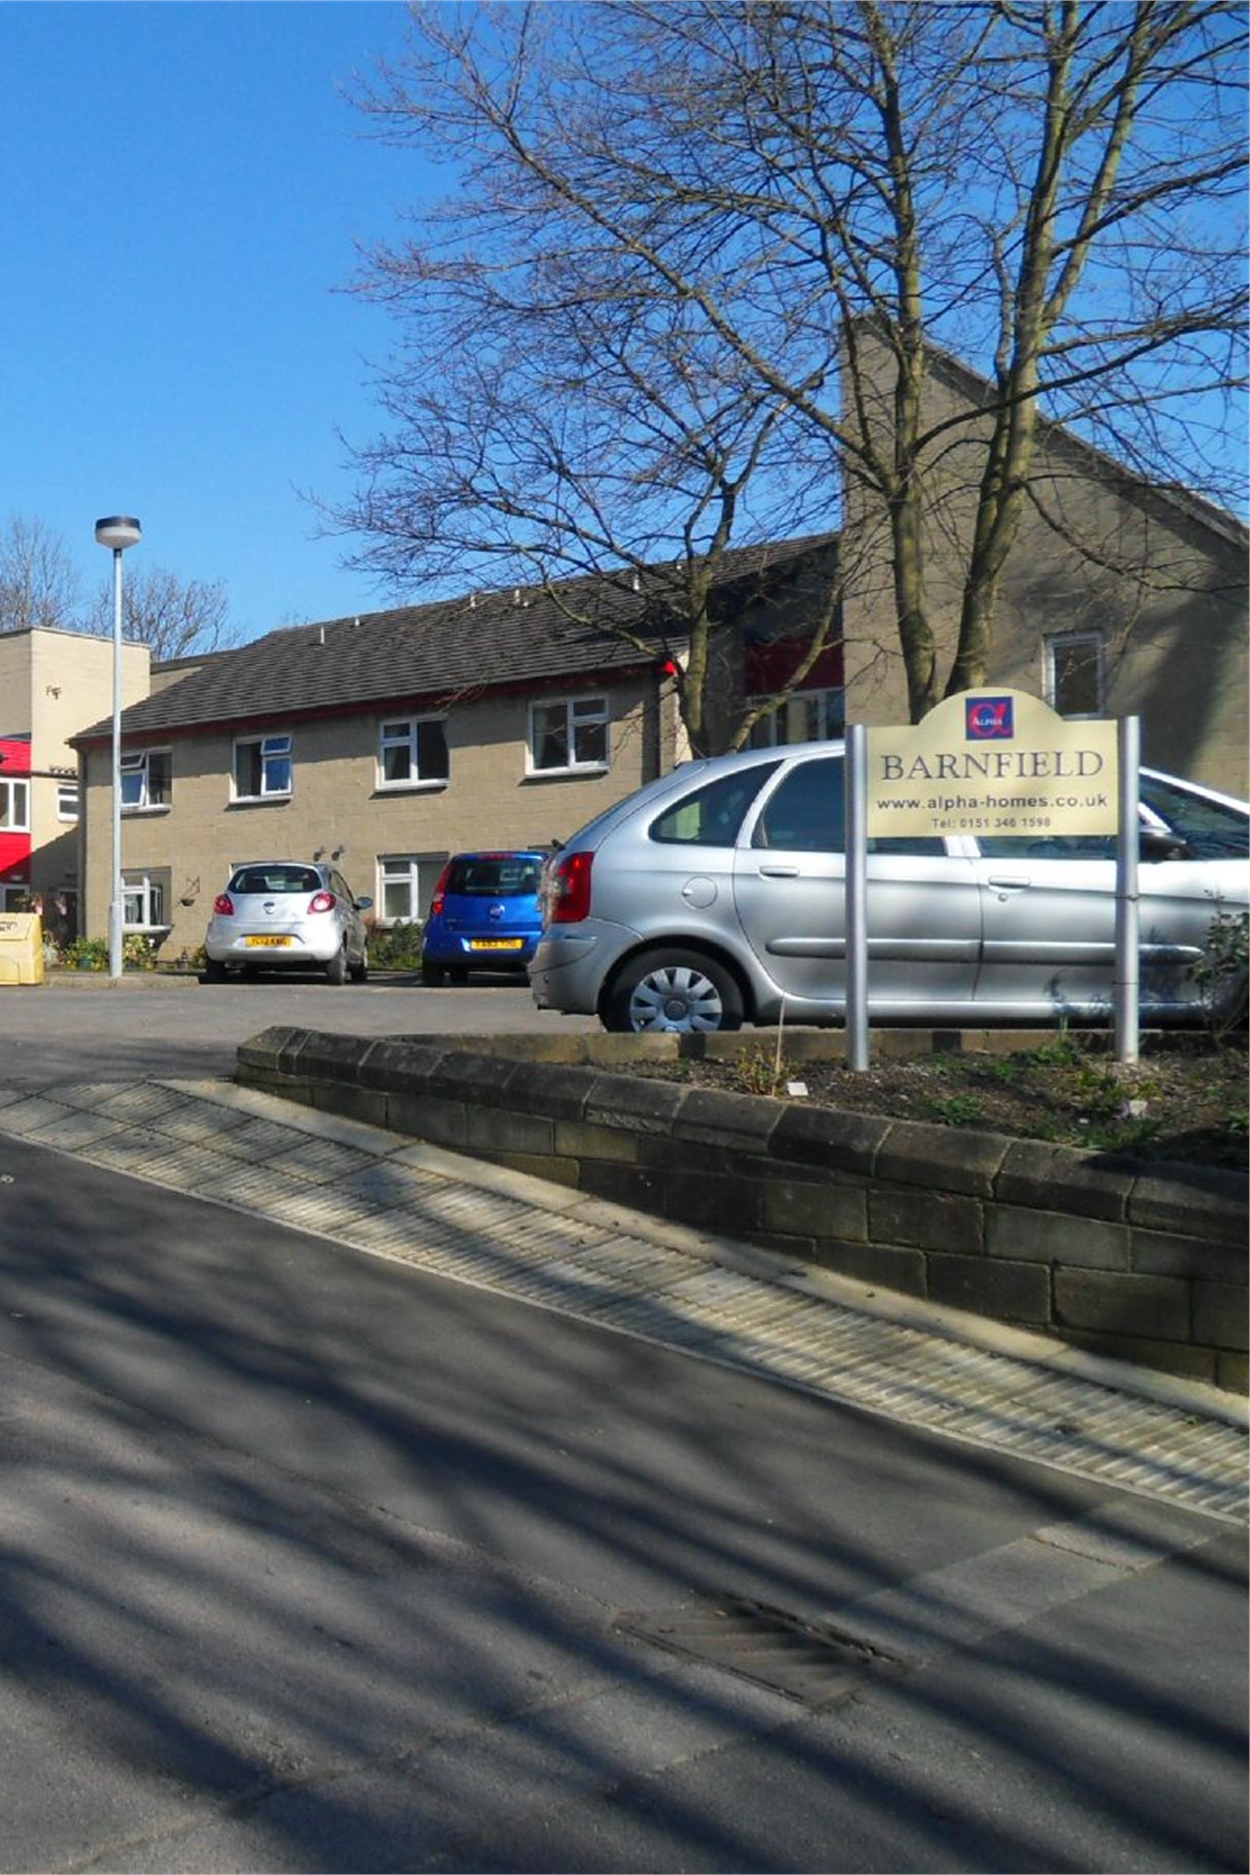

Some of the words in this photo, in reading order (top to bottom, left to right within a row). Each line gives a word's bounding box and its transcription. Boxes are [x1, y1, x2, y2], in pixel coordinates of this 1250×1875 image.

[880, 750, 1104, 781] BARNFIELD
[877, 794, 1108, 811] www.alpha-homes.co.uk
[931, 818, 956, 829] Tel:
[960, 818, 990, 828] 0151
